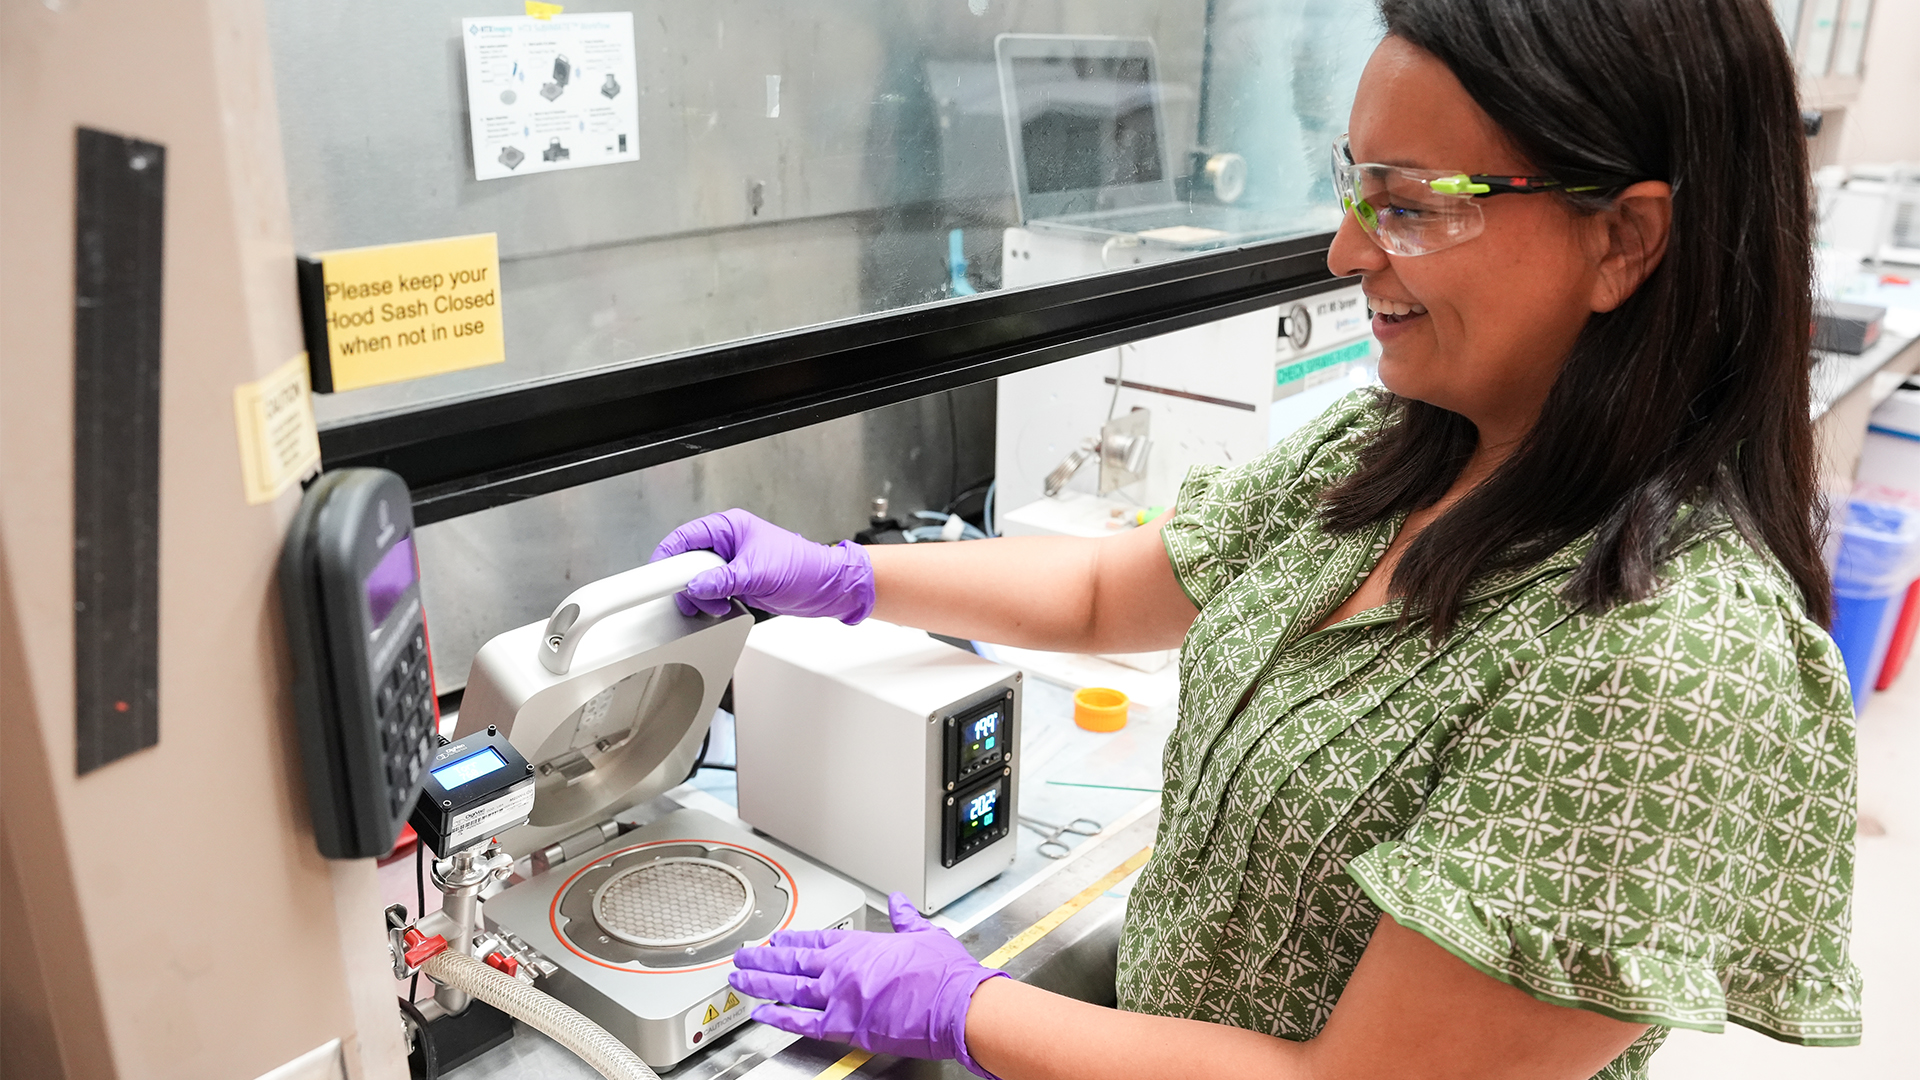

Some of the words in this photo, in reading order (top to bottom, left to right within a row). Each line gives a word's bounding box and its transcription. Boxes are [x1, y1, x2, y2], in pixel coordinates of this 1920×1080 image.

[325, 280, 394, 302] Please
[398, 273, 444, 293] keep
[449, 266, 488, 290] your
[381, 298, 429, 323] Sash
[434, 289, 495, 314] Closed
[339, 334, 392, 357] when
[397, 327, 427, 347] not
[431, 323, 448, 341] in
[453, 320, 485, 338] use
[453, 761, 477, 774] Torr
[703, 1014, 732, 1037] CAUTION
[732, 1006, 747, 1019] HOT
